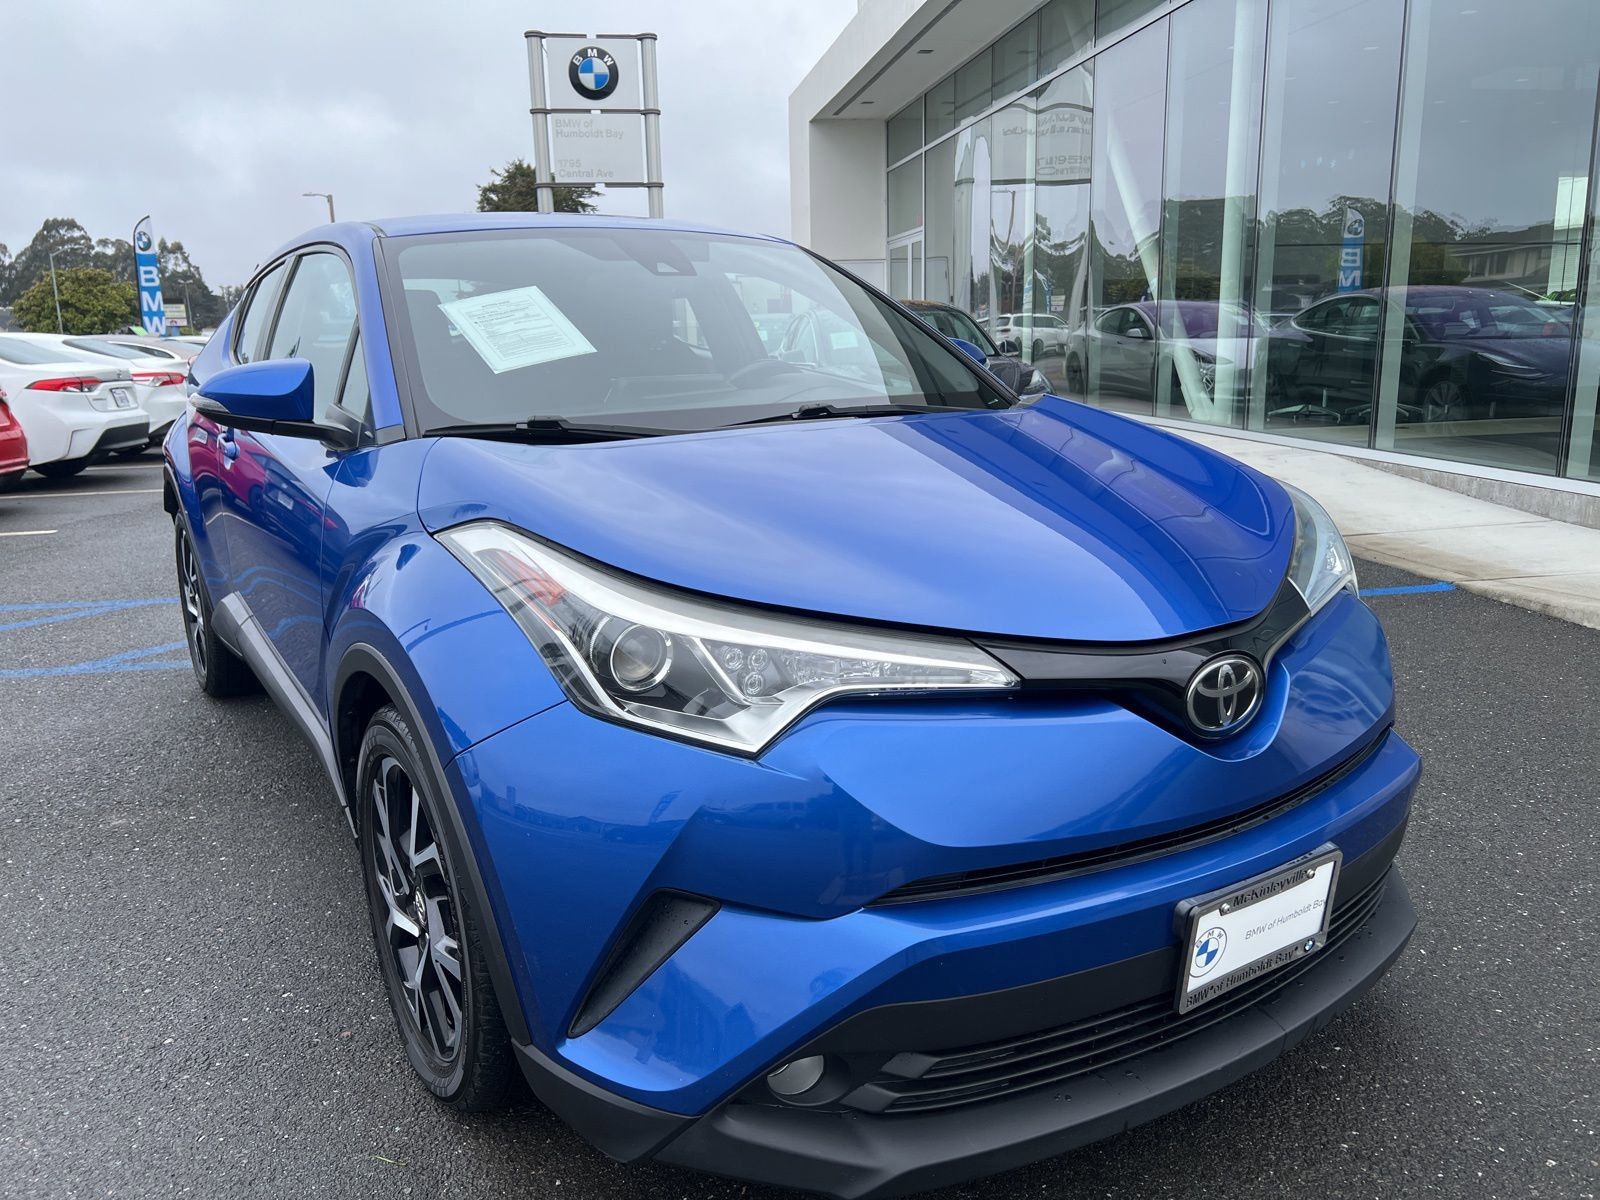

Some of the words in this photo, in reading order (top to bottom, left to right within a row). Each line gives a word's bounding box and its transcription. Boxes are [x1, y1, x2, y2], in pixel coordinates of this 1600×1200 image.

[572, 48, 614, 66] BMW
[555, 119, 580, 128] BMW
[583, 119, 593, 128] of
[555, 129, 604, 138] Humboldt
[606, 129, 624, 140] Bay
[558, 168, 594, 178] Central
[596, 168, 615, 178] Ave
[140, 266, 166, 338] BMW
[1233, 868, 1309, 908] McKinleyville
[1245, 924, 1267, 940] BMW
[1267, 918, 1276, 930] of
[1276, 904, 1312, 926] Humboldt
[1213, 980, 1225, 994] of
[1226, 957, 1274, 988] Humboldt
